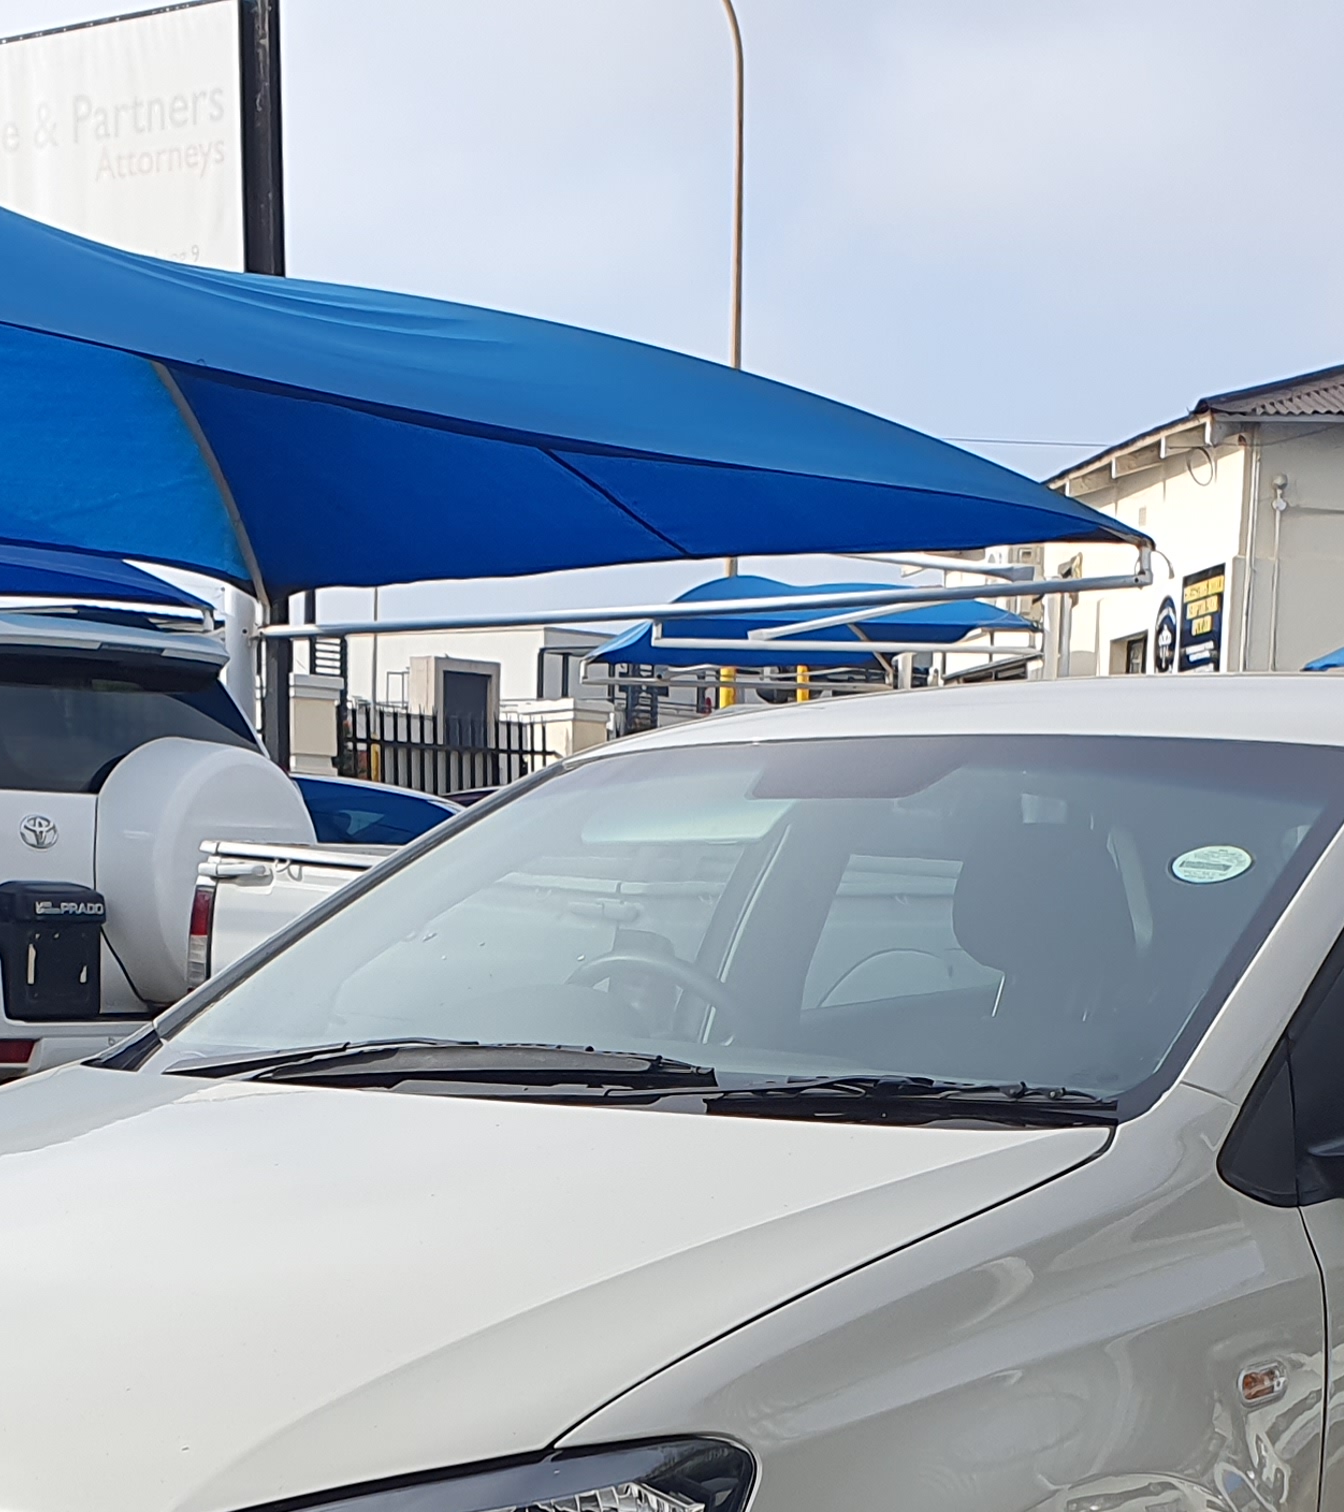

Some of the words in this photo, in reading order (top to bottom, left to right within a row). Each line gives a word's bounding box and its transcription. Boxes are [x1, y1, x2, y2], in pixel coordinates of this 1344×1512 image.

[34, 101, 58, 150] &
[72, 86, 225, 143] Partners
[95, 138, 225, 182] Attorneys
[61, 902, 104, 915] PRADO
